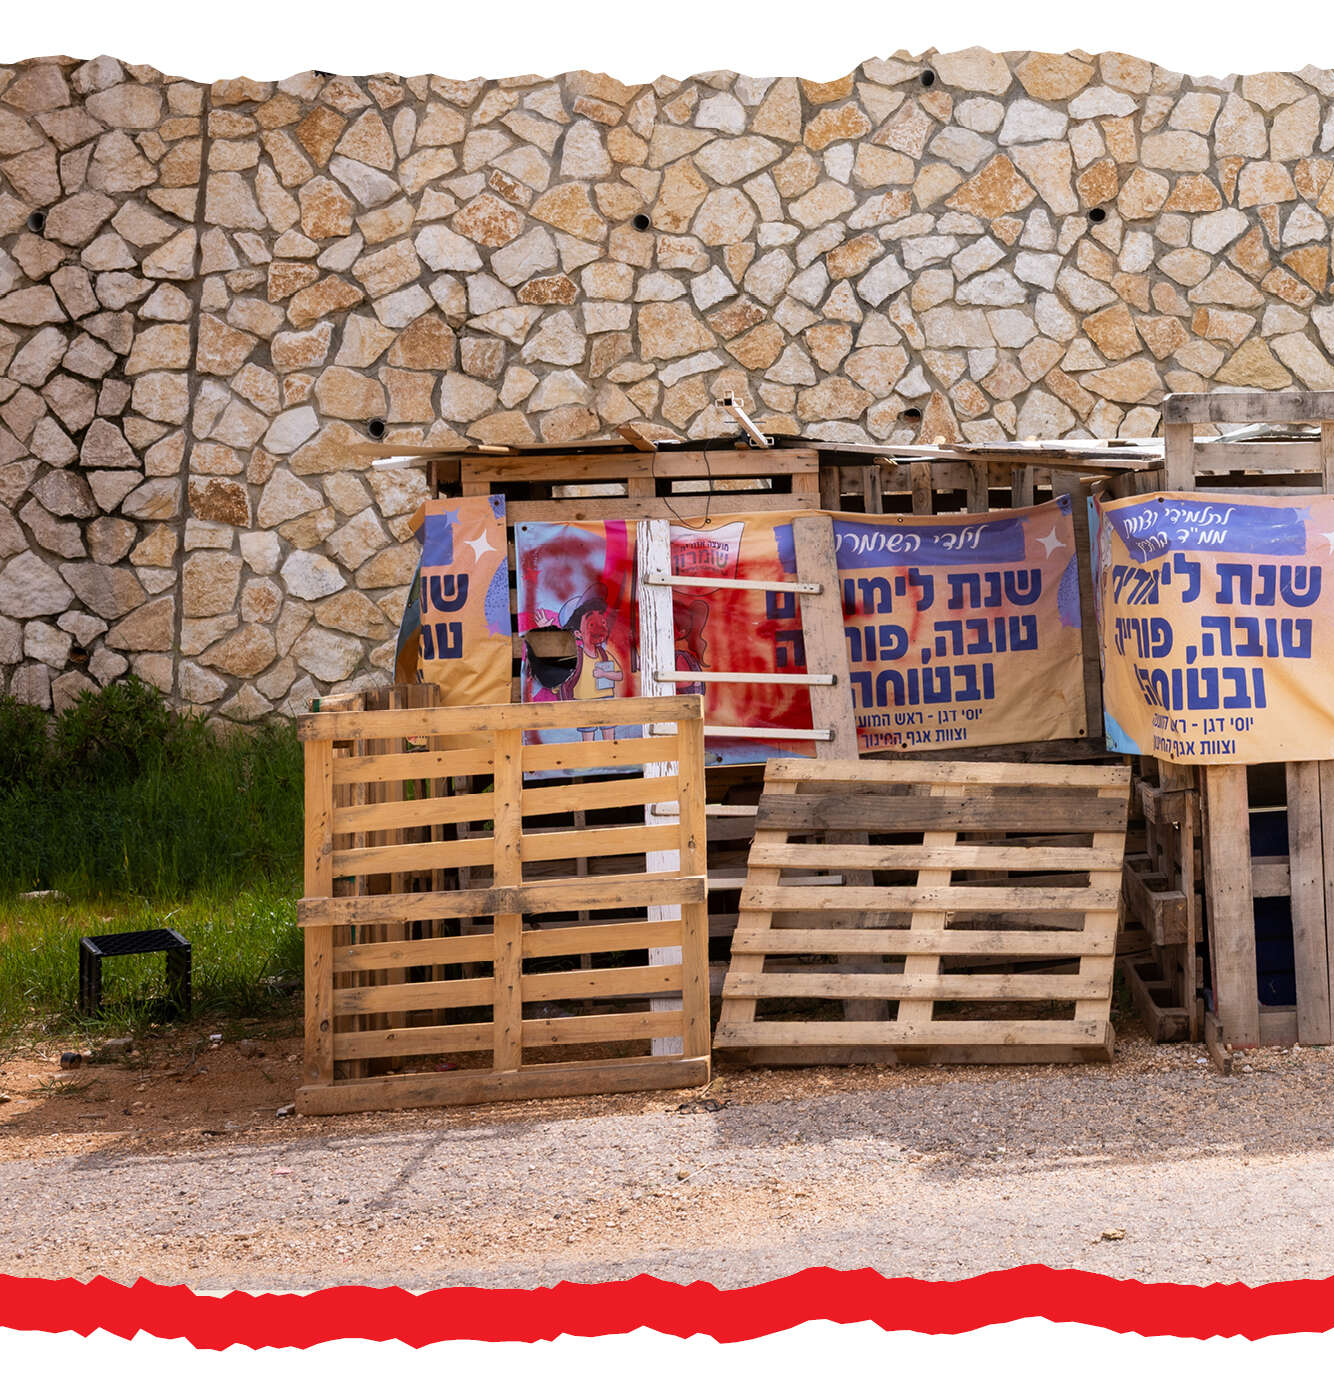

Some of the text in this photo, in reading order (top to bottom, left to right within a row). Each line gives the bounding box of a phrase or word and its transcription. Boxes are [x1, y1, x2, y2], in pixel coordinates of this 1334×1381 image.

[1123, 506, 1236, 539] לתלמידי וצוות
[835, 525, 989, 555] לילדי השומרו
[948, 569, 1042, 609] שנת
[1215, 563, 1322, 607] שנת
[921, 615, 1038, 664] טובה,
[1186, 615, 1312, 664] טובה,
[855, 713, 890, 728] המוע
[895, 711, 923, 726] ראש
[938, 710, 957, 724] דגן
[961, 708, 983, 720] יוסי
[1203, 718, 1225, 735] דגן
[1230, 717, 1254, 731] יוסי
[906, 730, 931, 746] אגף
[936, 728, 967, 742] וצוות
[1173, 740, 1195, 757] אגף
[1200, 740, 1236, 755] וצוות
